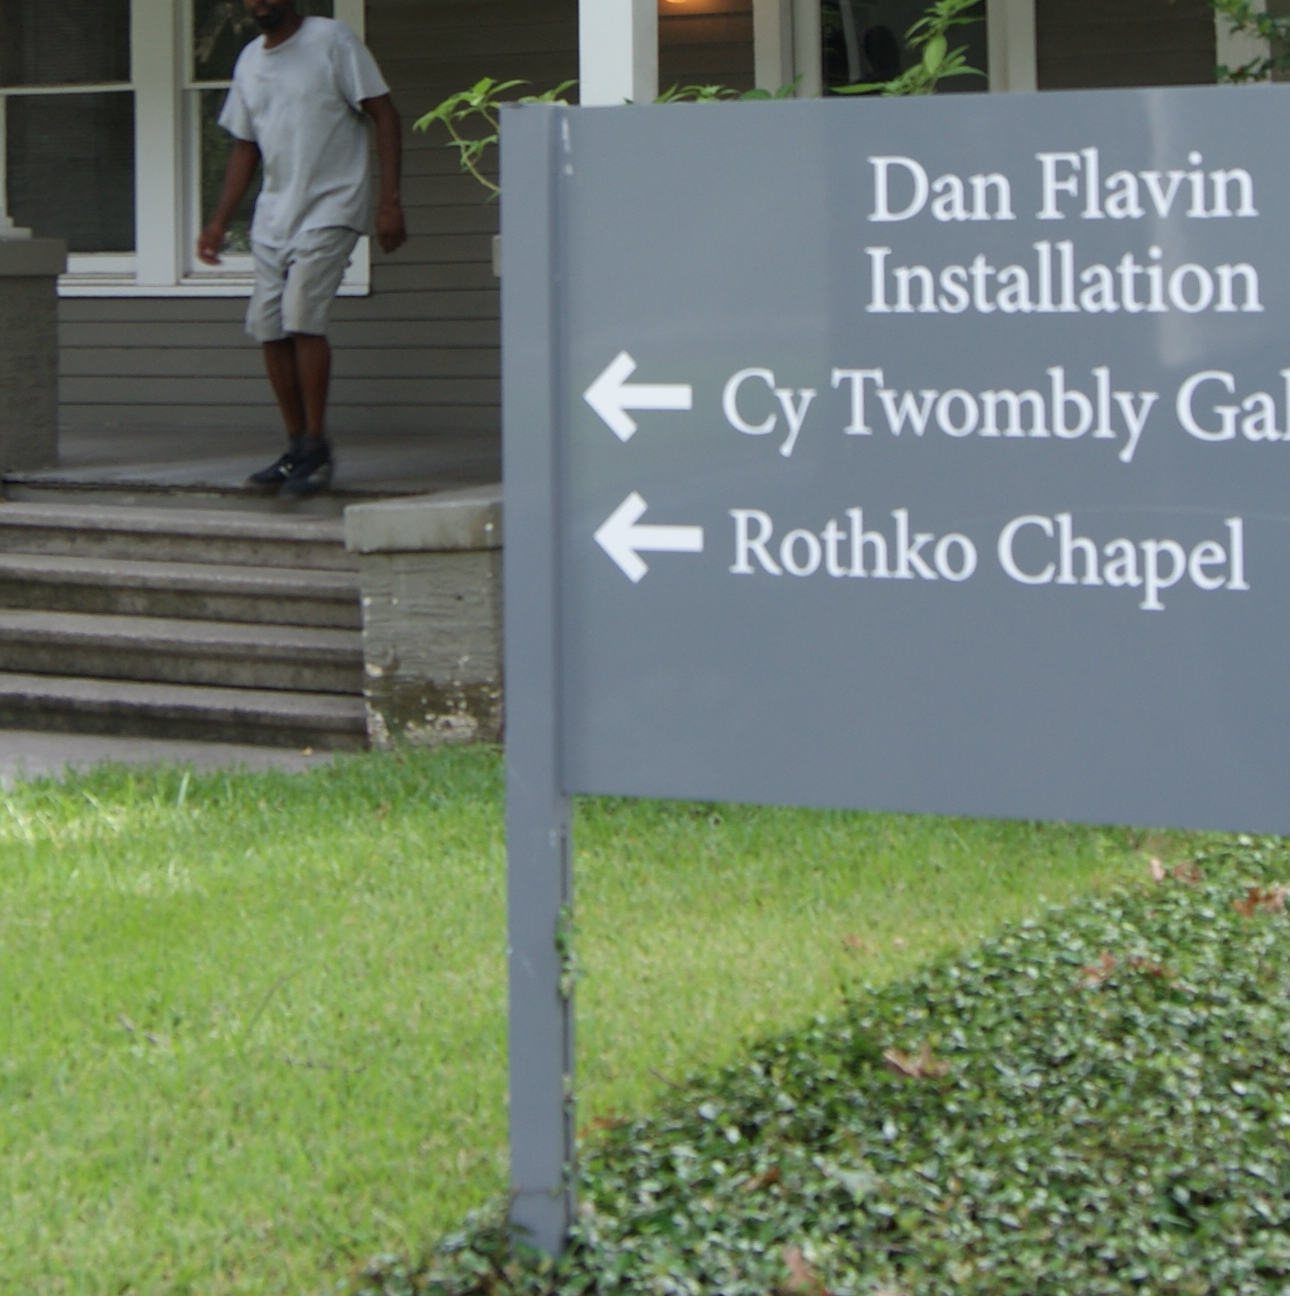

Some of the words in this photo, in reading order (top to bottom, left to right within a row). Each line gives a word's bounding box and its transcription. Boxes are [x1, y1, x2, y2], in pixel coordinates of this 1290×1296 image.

[868, 155, 1016, 223] Dan
[1036, 146, 1259, 221] Flavin
[865, 239, 1265, 315] Installation
[721, 366, 817, 458] Cy
[830, 365, 1160, 464] Twombly
[729, 506, 978, 582] Rothko
[997, 511, 1250, 612] Chapel
